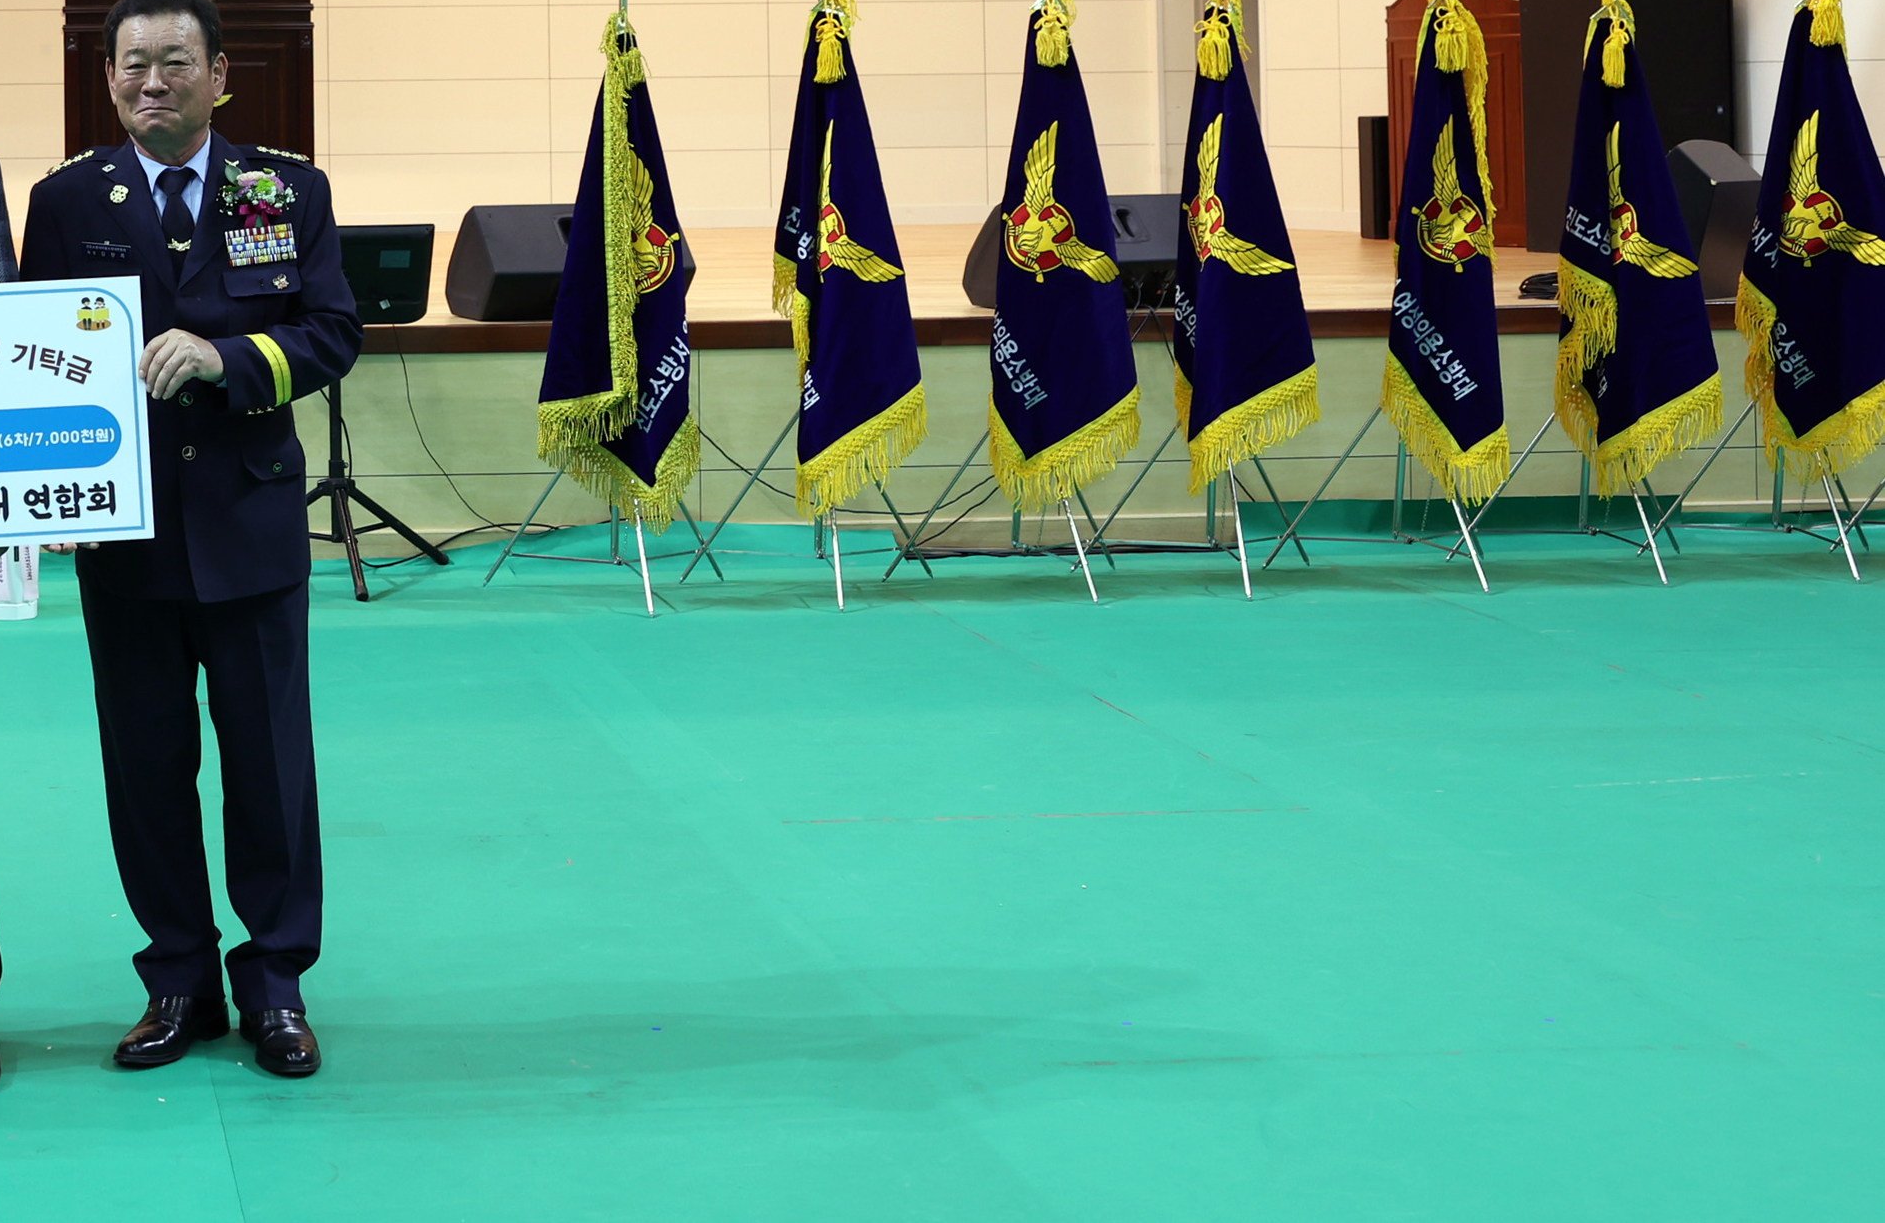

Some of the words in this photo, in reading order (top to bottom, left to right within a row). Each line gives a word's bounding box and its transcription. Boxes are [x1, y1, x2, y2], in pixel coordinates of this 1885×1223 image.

[11, 343, 93, 384] 기탁금
[1394, 292, 1478, 401] 여성의용소방대
[22, 480, 117, 520] 연합회
